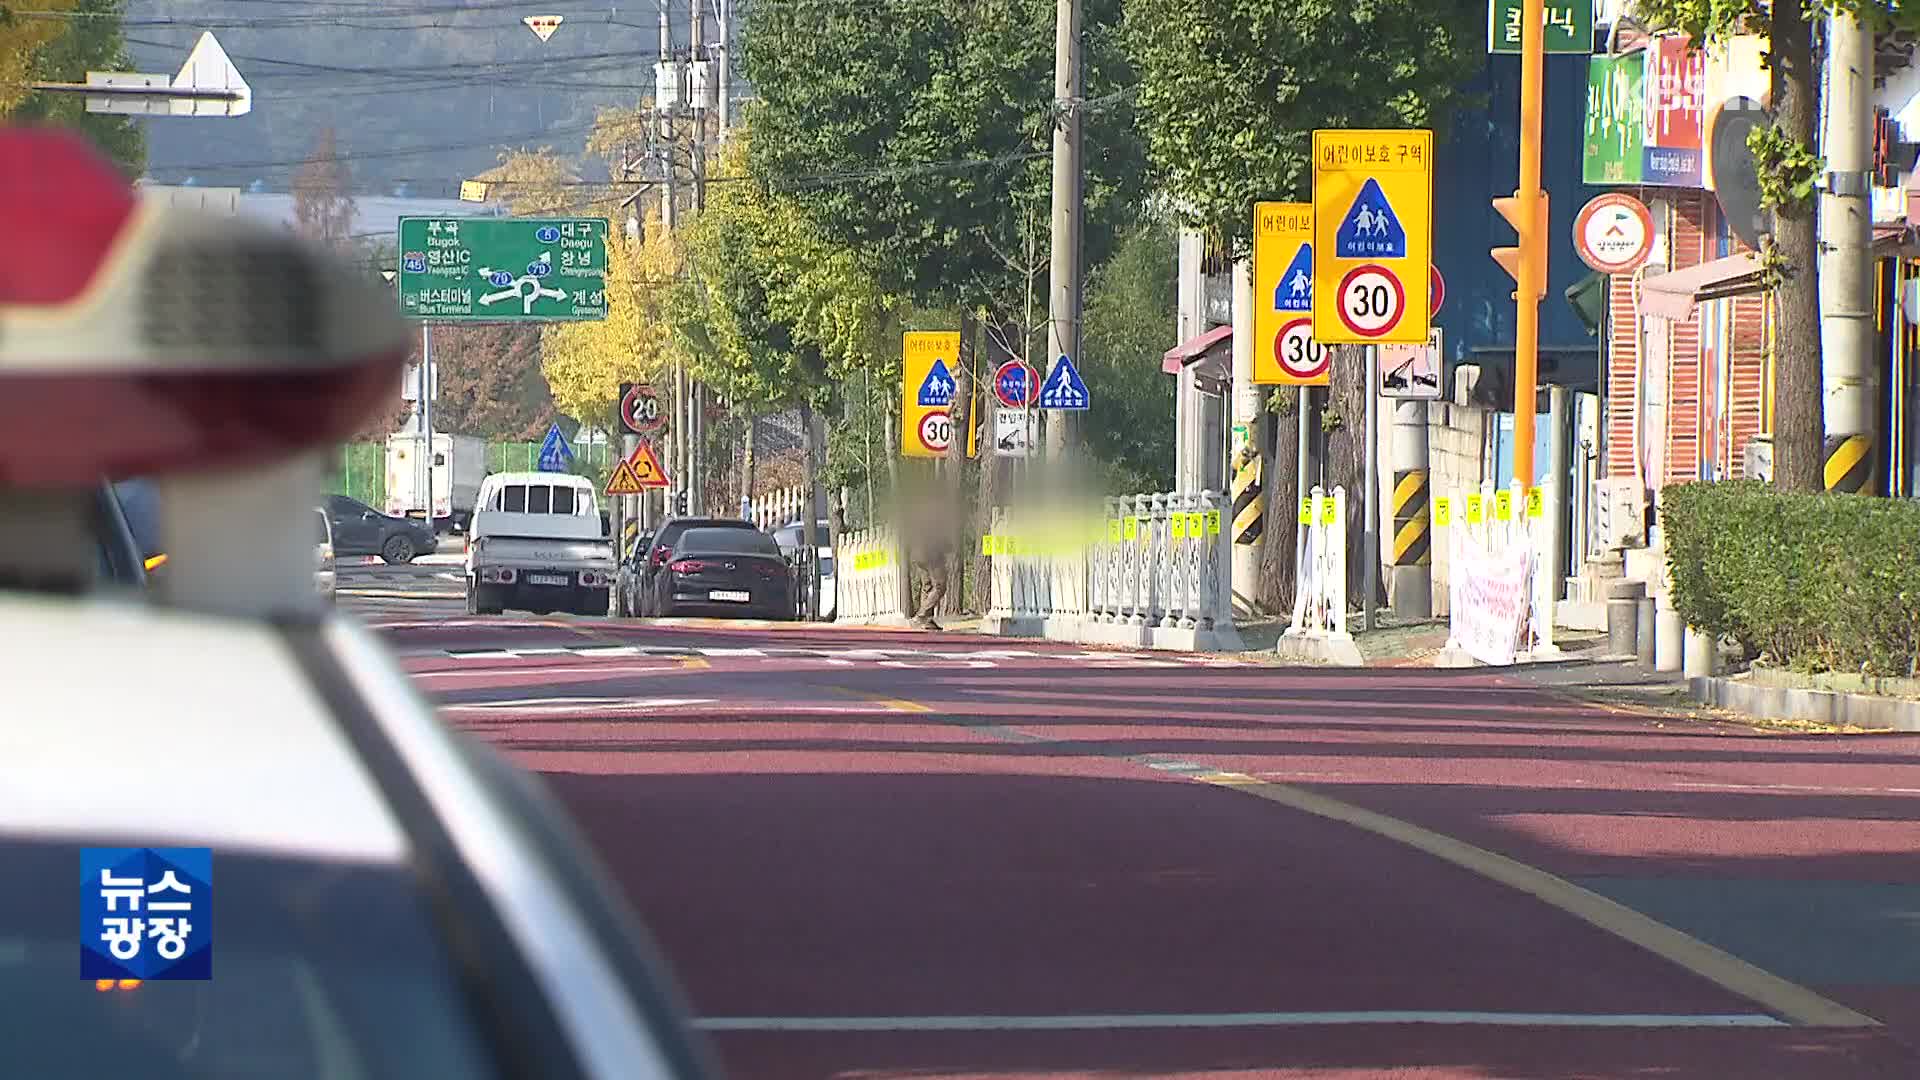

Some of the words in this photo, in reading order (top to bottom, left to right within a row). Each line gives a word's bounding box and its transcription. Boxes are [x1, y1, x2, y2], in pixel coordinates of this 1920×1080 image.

[1504, 7, 1575, 42] 클닉
[1322, 144, 1390, 164] 어린이보호
[1396, 144, 1422, 164] 구역
[561, 223, 592, 238] 대구
[1347, 241, 1394, 252] 어린이보호
[420, 288, 471, 304] 버스터미널
[1353, 284, 1389, 317] 30
[1288, 335, 1321, 363] 30
[633, 399, 657, 420] 20
[927, 421, 949, 442] 30
